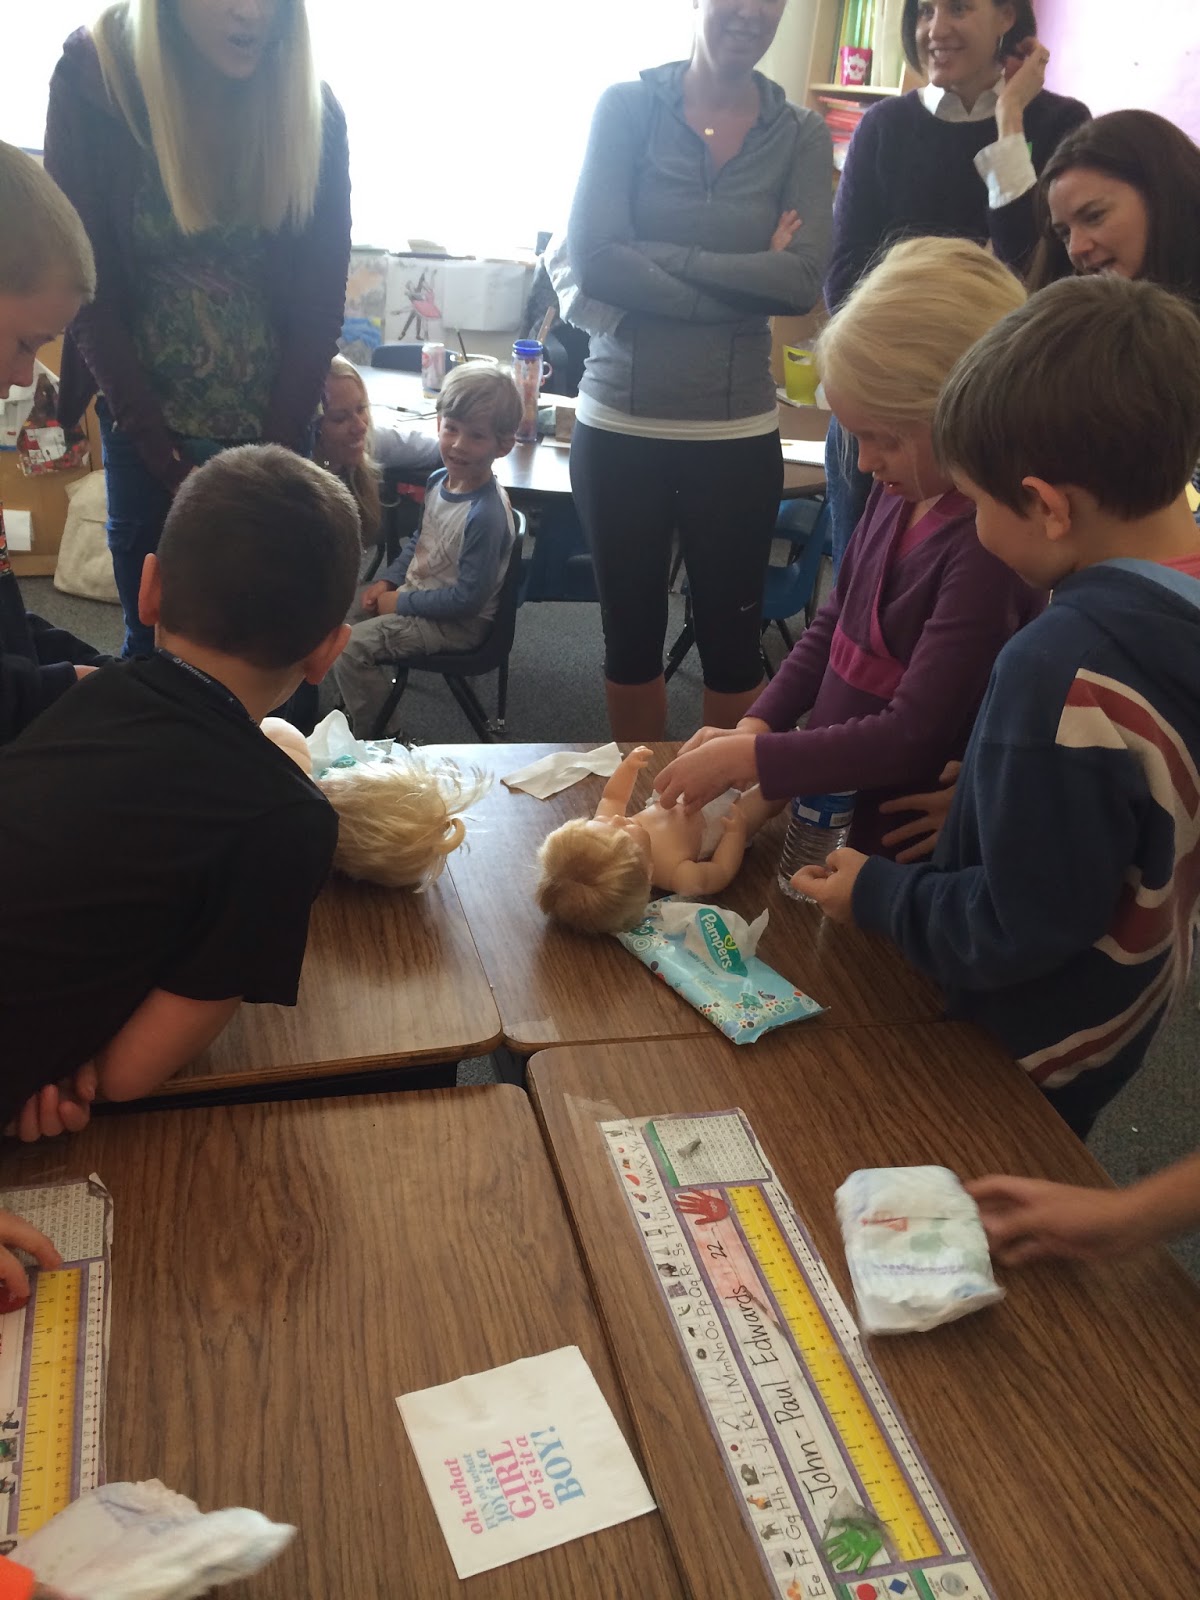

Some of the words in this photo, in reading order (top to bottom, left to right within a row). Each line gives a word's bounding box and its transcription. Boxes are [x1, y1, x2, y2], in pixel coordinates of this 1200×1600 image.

[701, 913, 732, 969] Pampers
[706, 1240, 727, 1260] 22
[725, 1285, 779, 1366] Edwards
[516, 1435, 528, 1447] a
[477, 1449, 487, 1458] a
[520, 1451, 535, 1465] it
[463, 1453, 480, 1483] what
[479, 1463, 492, 1473] it
[530, 1426, 586, 1505] BOY!
[444, 1458, 472, 1506] what
[486, 1477, 499, 1490] is
[489, 1440, 536, 1518] GIRL
[528, 1469, 544, 1485] is
[475, 1486, 487, 1499] oh
[537, 1489, 554, 1509] or
[491, 1496, 515, 1522] JOY
[462, 1509, 483, 1534] oh
